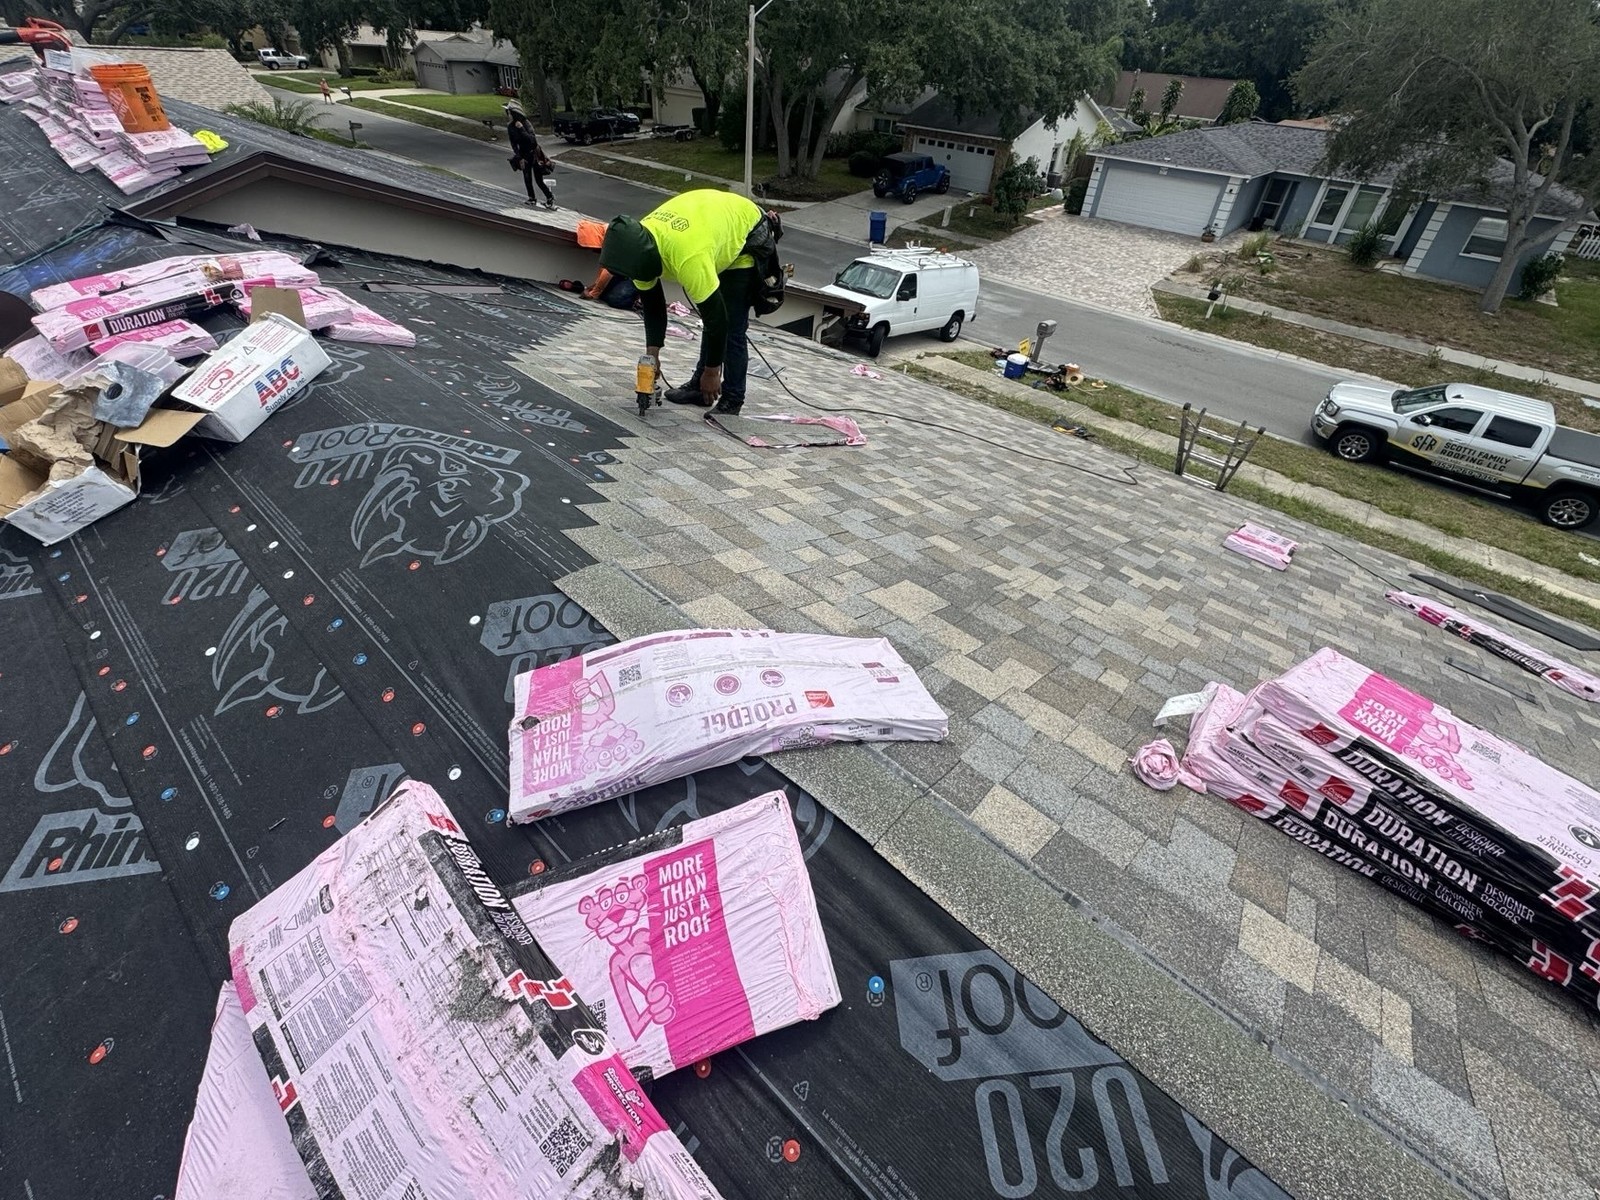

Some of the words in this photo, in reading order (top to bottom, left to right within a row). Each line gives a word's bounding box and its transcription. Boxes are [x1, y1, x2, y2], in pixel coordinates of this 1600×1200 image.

[109, 308, 166, 333] DURATION
[254, 355, 300, 408] ABC
[265, 394, 287, 413] Supply
[1411, 434, 1437, 451] SFR
[1443, 442, 1477, 457] SCOTTI
[1477, 450, 1511, 465] FAMILY
[294, 451, 374, 489] U20
[1439, 449, 1484, 467] ROOFING
[1486, 461, 1507, 472] LLC
[698, 694, 797, 739] PROEDGE
[533, 737, 542, 749] A
[544, 728, 571, 747] JUST
[532, 743, 572, 768] THAN
[532, 759, 572, 785] MORE
[1341, 751, 1454, 826] DURATION
[1455, 822, 1507, 858] DESIGNER
[1274, 817, 1379, 877] DURATION
[1323, 810, 1430, 888] DURATION
[1436, 881, 1483, 919] DESIGNER
[1364, 805, 1480, 893] DURATION
[1484, 882, 1535, 923] DESIGNER
[658, 853, 705, 885] MORE
[451, 839, 509, 910] DURATION
[502, 908, 533, 946] DESIGNER
[661, 872, 707, 907] THAN
[1435, 886, 1475, 921] COLORS
[663, 898, 695, 926] JUST
[700, 893, 710, 911] A
[1480, 893, 1521, 924] COLORS
[663, 911, 712, 949] ROOF
[601, 1072, 645, 1125] PROTECTION
[974, 1065, 1170, 1199] U20
[827, 1117, 859, 1150] resistencia
[861, 1153, 882, 1174] desliz
[878, 1172, 900, 1194] puede
[885, 1165, 900, 1181] Slip
